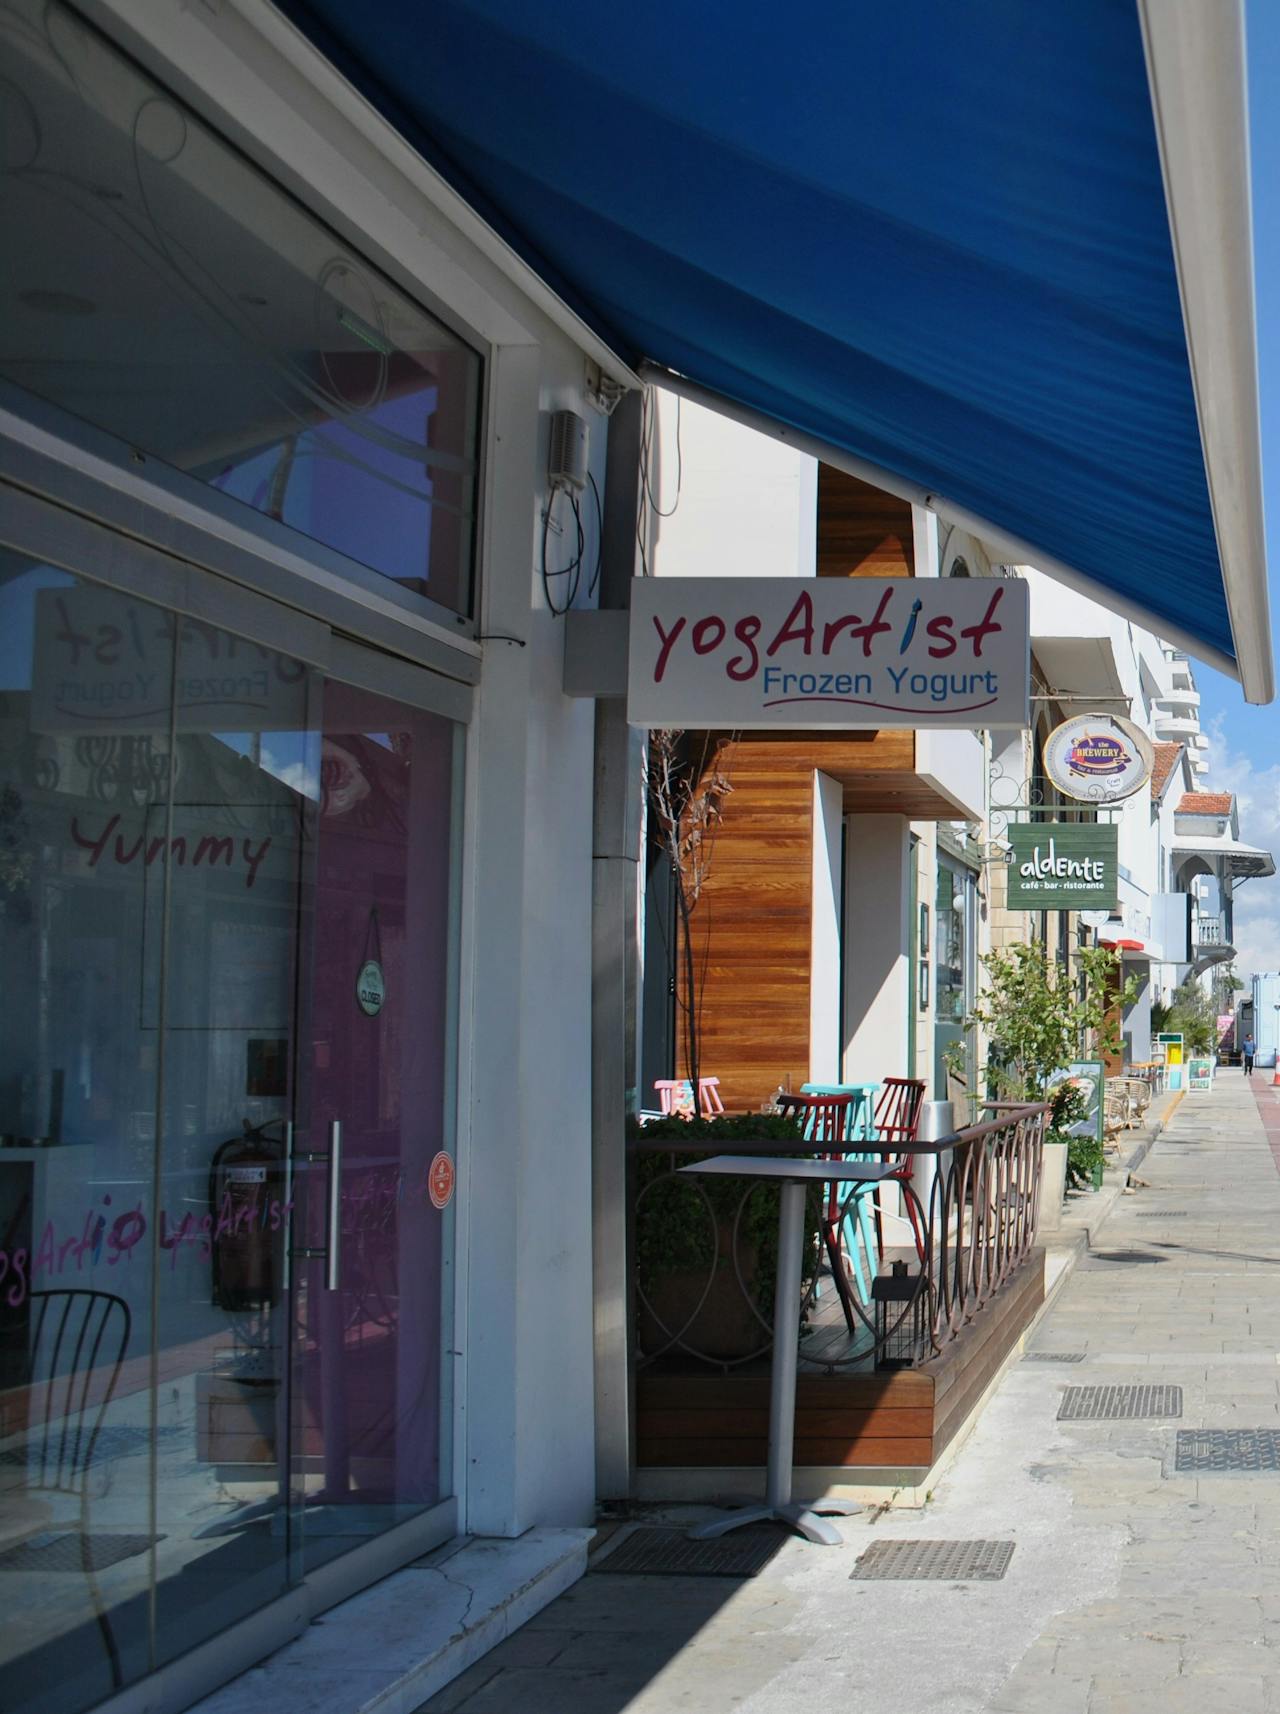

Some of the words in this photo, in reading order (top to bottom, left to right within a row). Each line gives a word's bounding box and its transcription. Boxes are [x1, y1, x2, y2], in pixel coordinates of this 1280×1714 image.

[652, 586, 1005, 683] yogArtist
[763, 667, 872, 694] Frozen
[886, 667, 999, 702] Yogurt
[1076, 748, 1119, 757] BREWERY
[70, 813, 272, 888] Yummy
[1020, 881, 1039, 890] café
[1044, 881, 1058, 890] bar
[1063, 881, 1105, 890] ristorante
